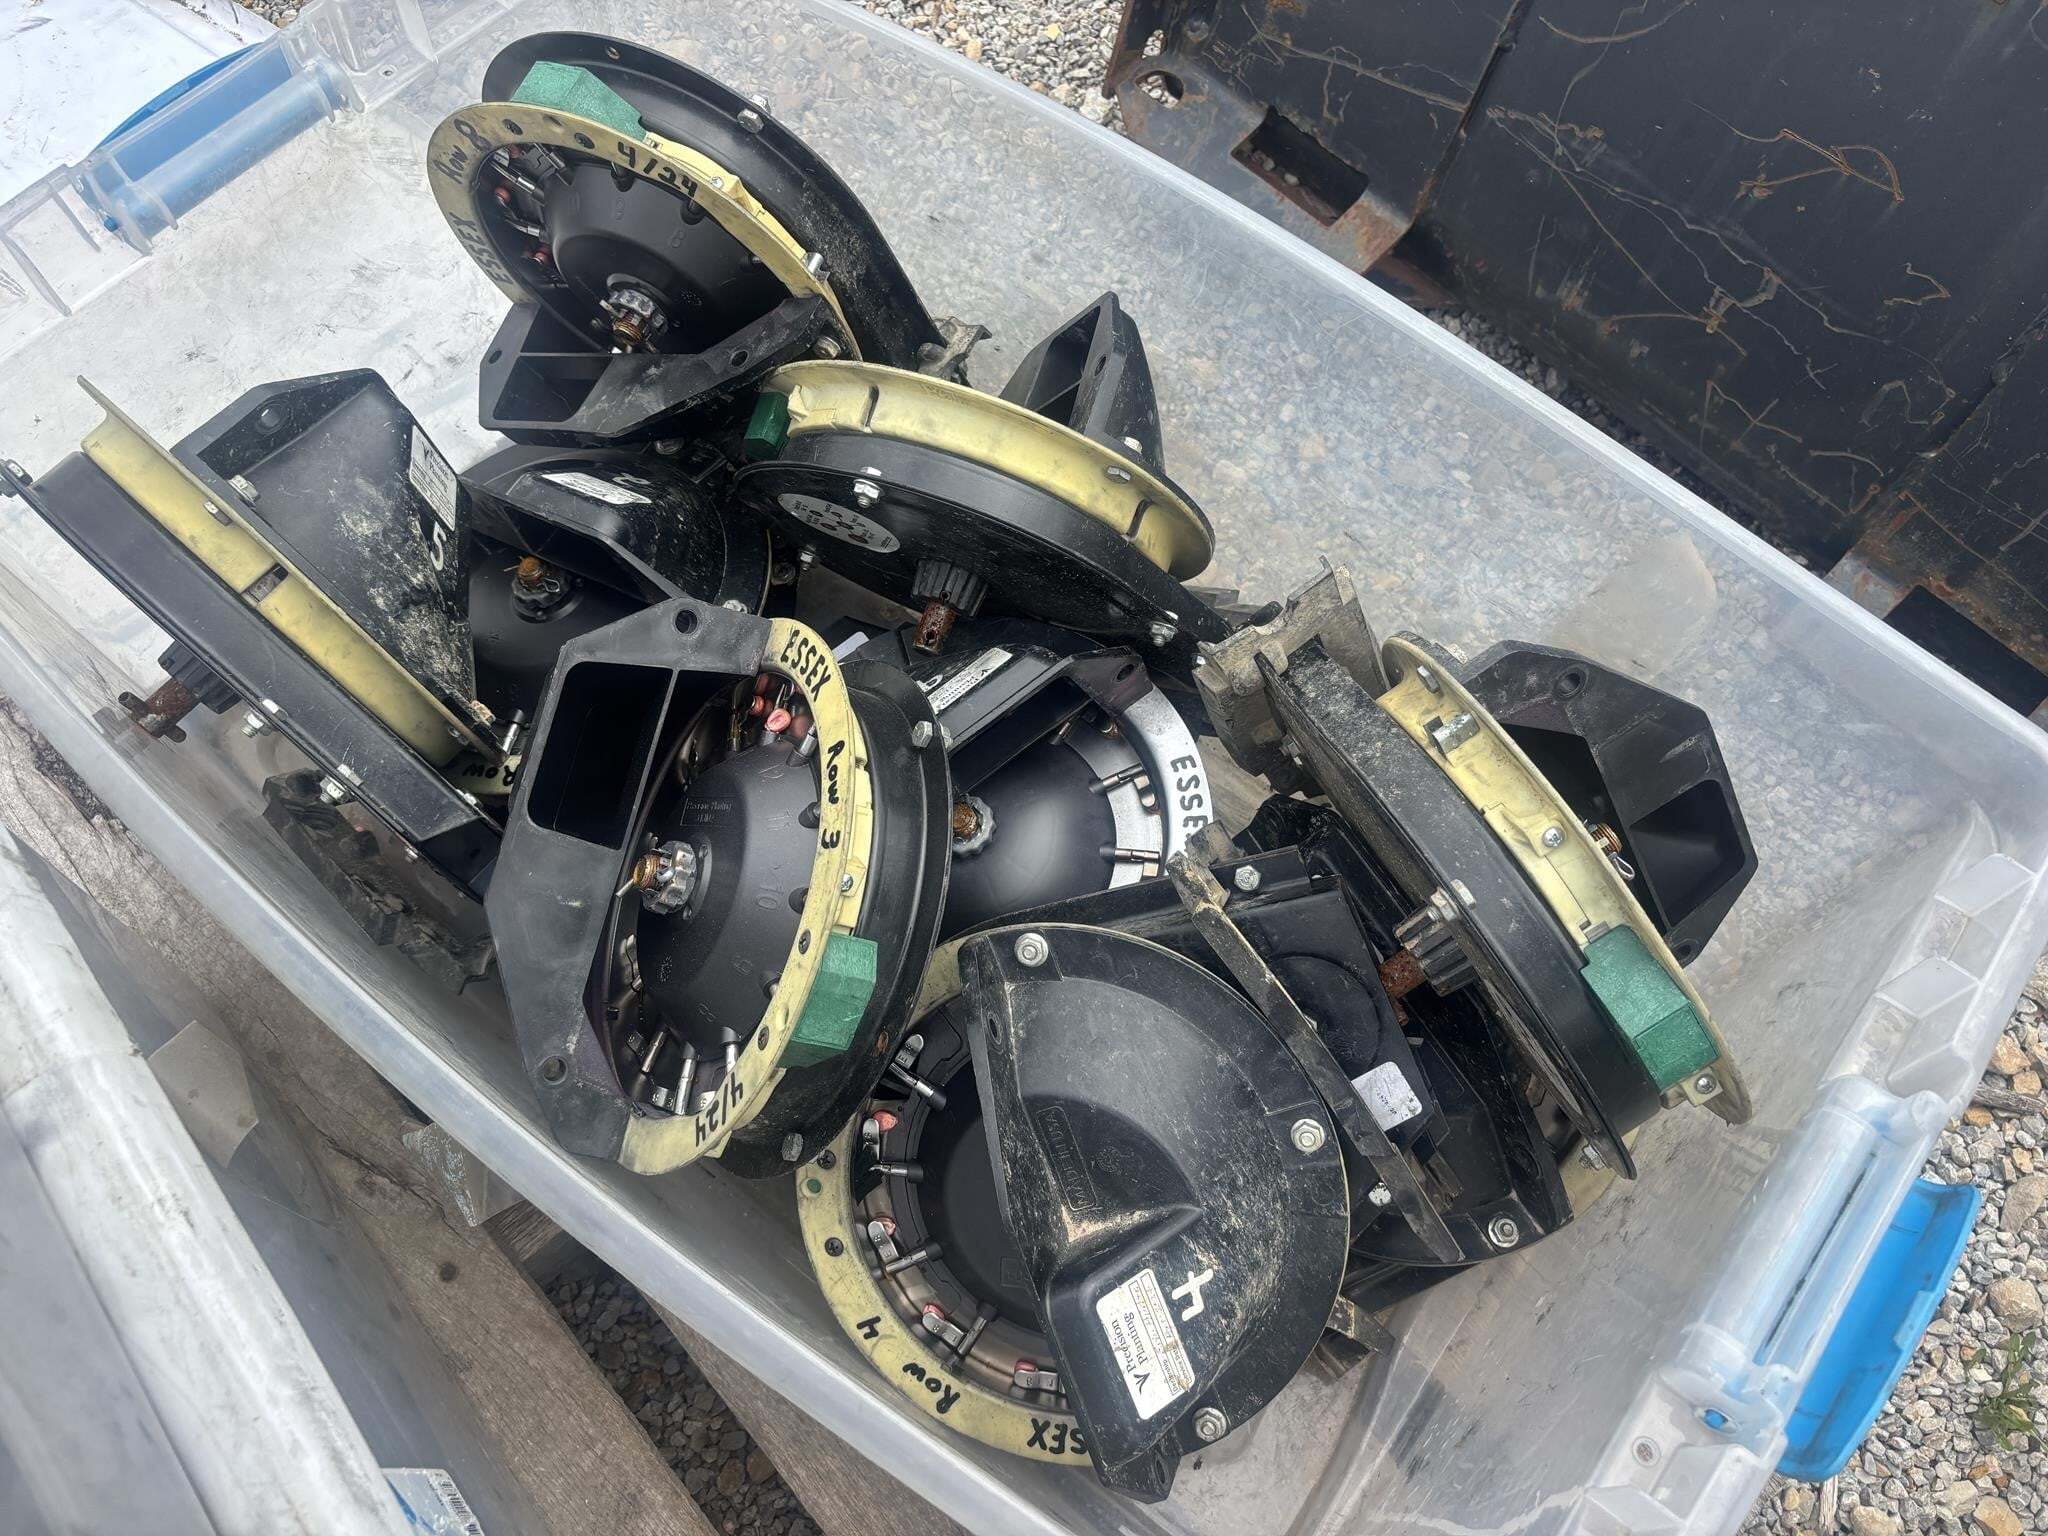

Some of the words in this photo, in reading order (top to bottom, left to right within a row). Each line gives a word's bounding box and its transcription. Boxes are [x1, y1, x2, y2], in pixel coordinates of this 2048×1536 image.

[454, 119, 492, 151] 8
[618, 142, 698, 198] 4/24
[450, 212, 513, 284] ESSEX
[430, 520, 447, 571] 5
[780, 629, 831, 702] ESSEX
[827, 739, 845, 806] Row
[1170, 755, 1209, 839] ESSE
[821, 828, 841, 850] 3
[695, 1071, 744, 1148] 4/24
[1171, 1268, 1214, 1322] 4
[856, 1315, 881, 1340] 4
[1111, 1319, 1137, 1374] Precision
[1123, 1312, 1149, 1365] Planting
[1026, 1417, 1088, 1455] SEX
